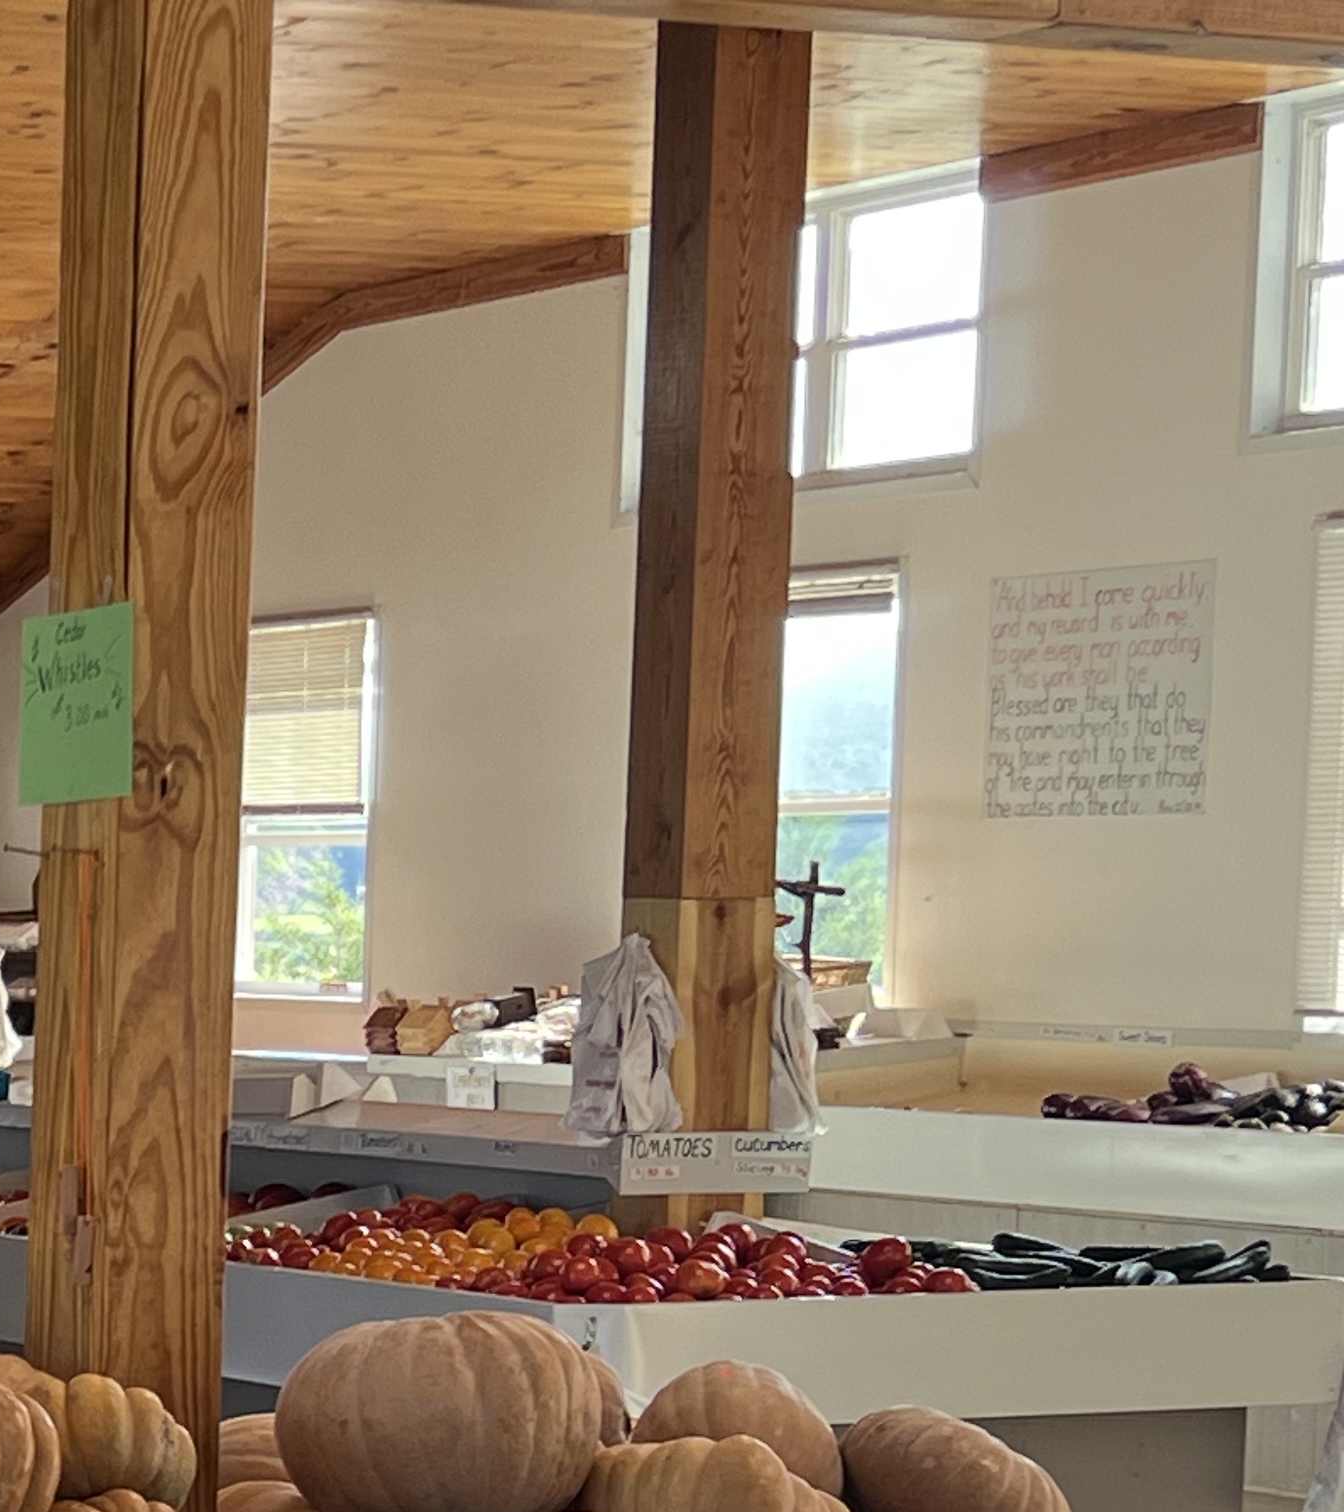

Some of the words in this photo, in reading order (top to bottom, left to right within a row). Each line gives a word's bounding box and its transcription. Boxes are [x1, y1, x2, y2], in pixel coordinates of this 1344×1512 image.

[1128, 632, 1201, 664] according
[38, 650, 101, 694] Whistles
[991, 686, 1049, 717] Blessed
[627, 1134, 713, 1159] TOMATOES
